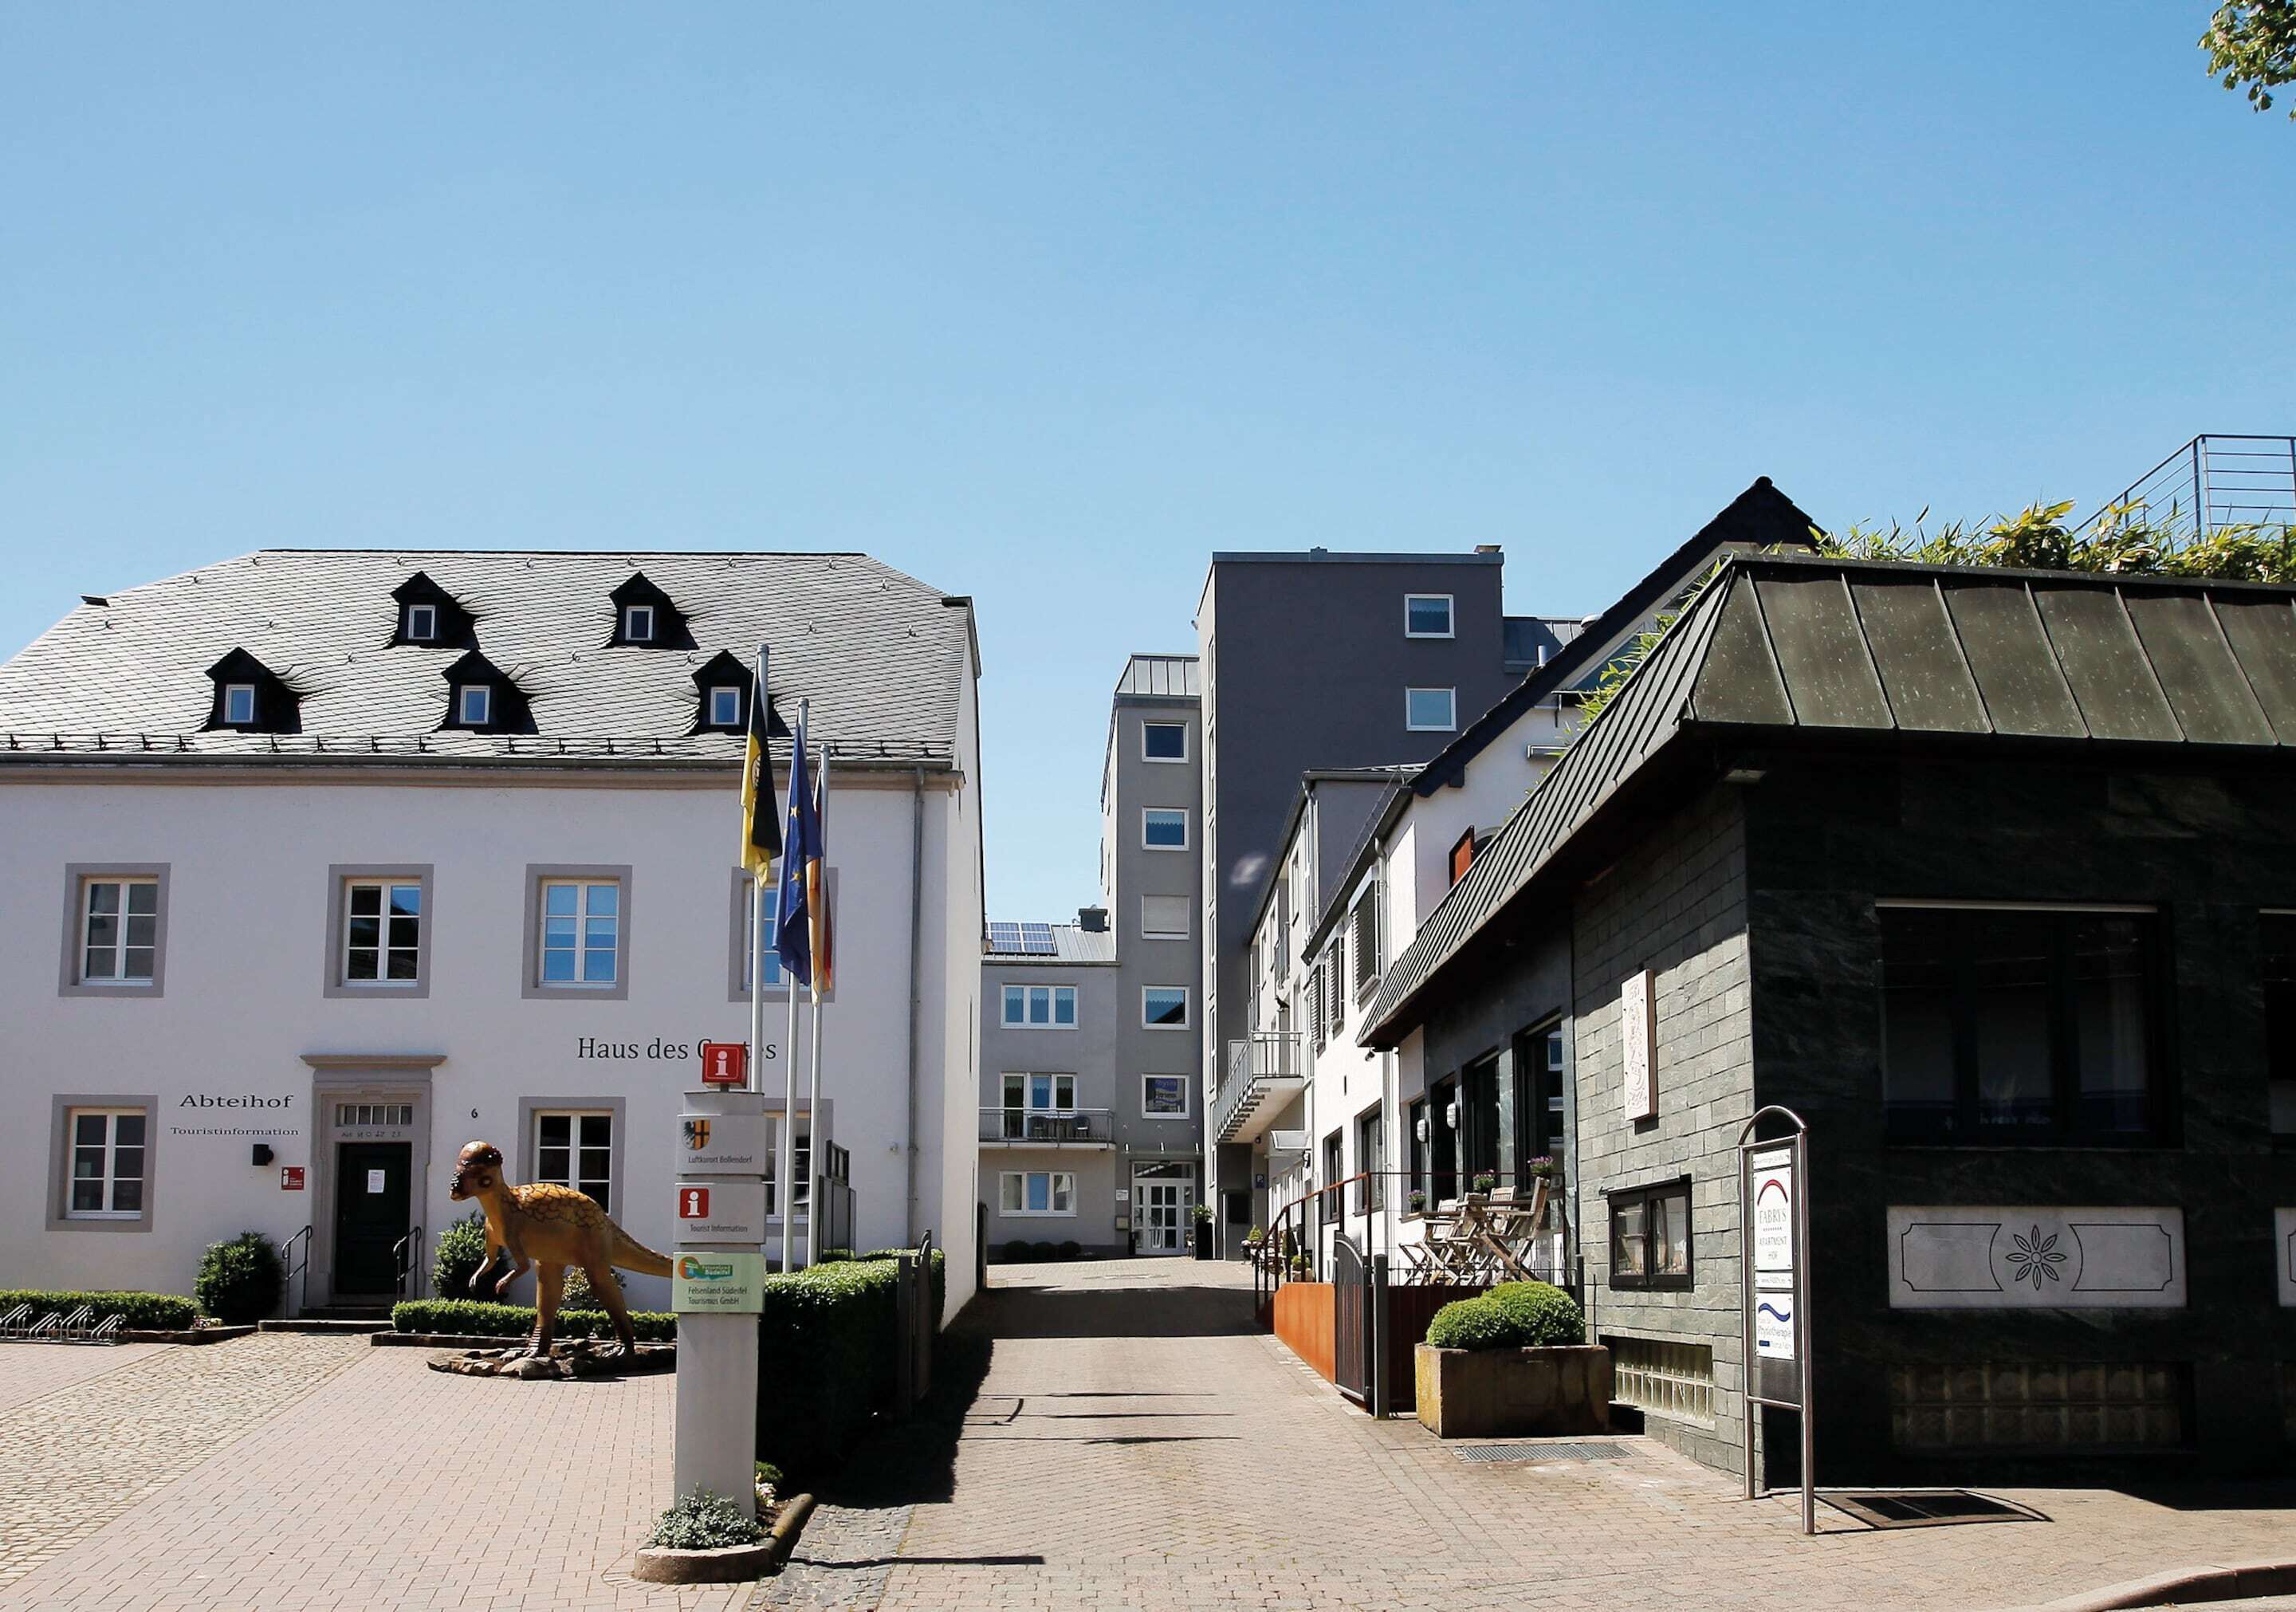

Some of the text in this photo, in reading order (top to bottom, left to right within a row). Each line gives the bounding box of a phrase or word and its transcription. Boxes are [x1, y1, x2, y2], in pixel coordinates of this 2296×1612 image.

[577, 1037, 639, 1060] Haus
[647, 1037, 688, 1060] des
[179, 1094, 294, 1108] Abteihof
[471, 1108, 478, 1119] 6
[170, 1126, 299, 1136] Touristinformation
[690, 1224, 748, 1233] Tourist Information
[688, 1286, 721, 1295] Felsenland
